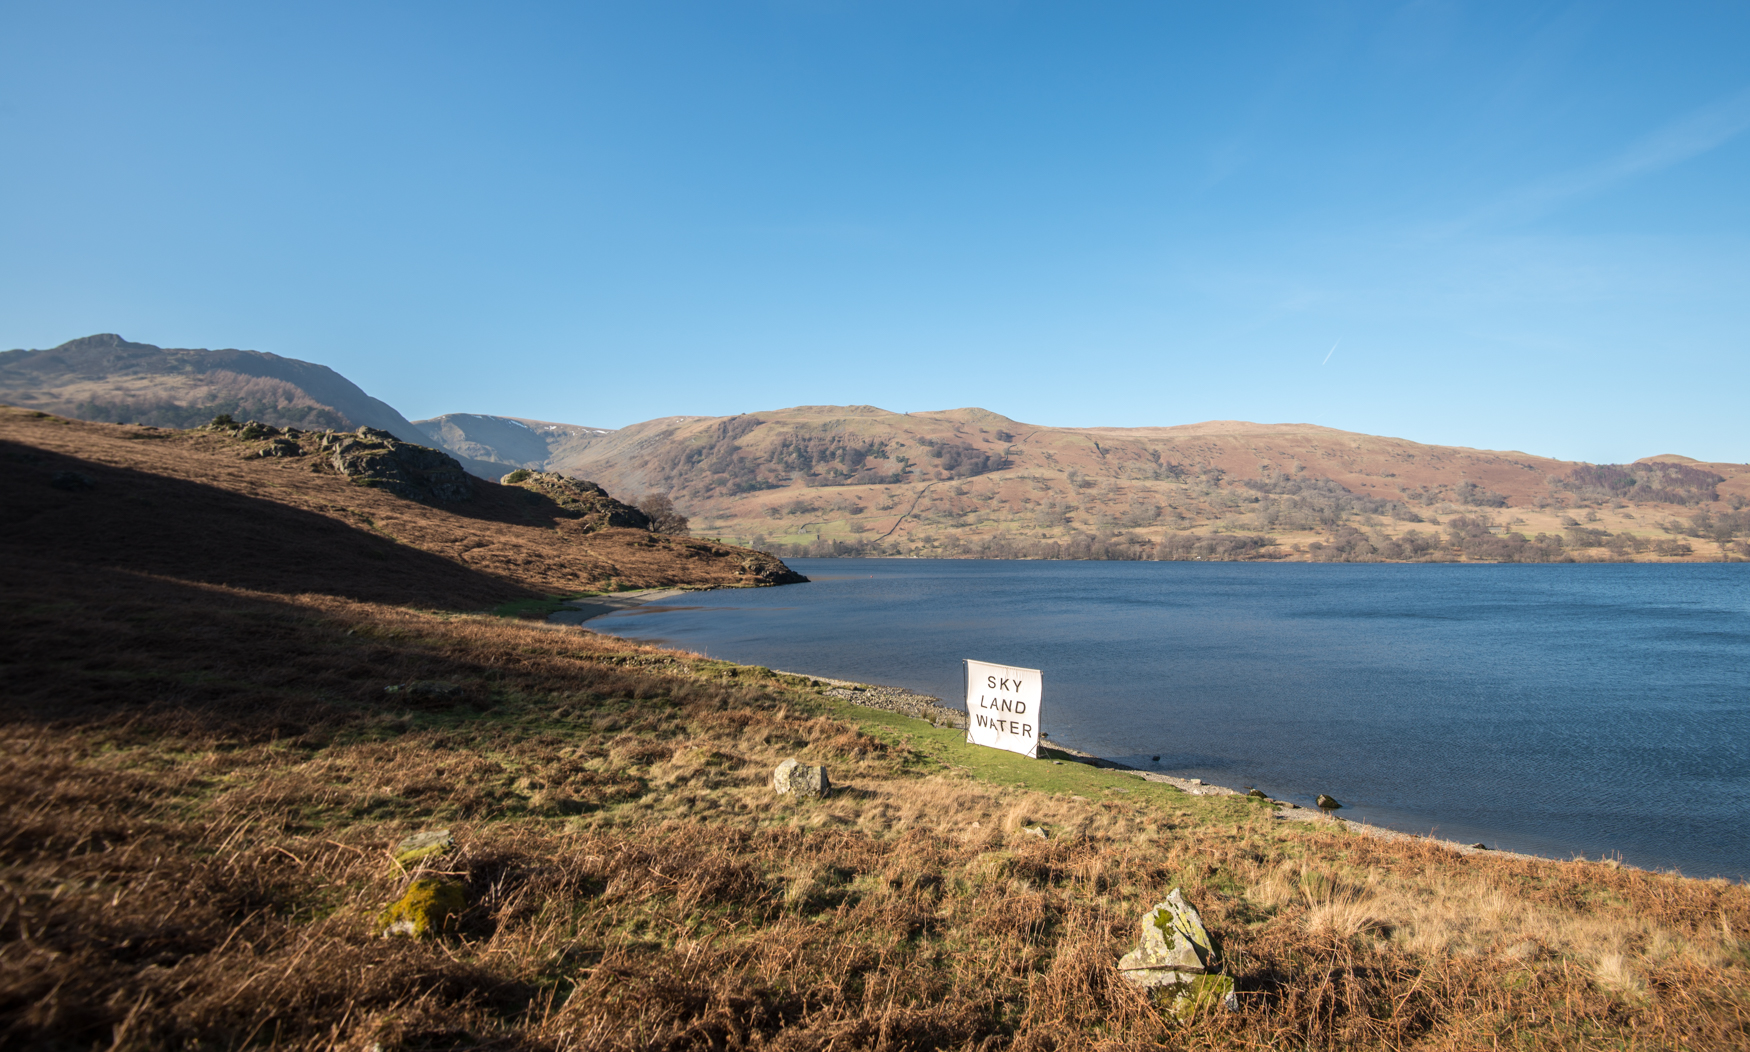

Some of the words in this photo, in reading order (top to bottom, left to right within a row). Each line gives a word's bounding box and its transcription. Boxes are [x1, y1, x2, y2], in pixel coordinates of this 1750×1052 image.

[987, 675, 1022, 693] SKY
[980, 695, 1027, 714] LAND
[976, 714, 1032, 738] WATER
